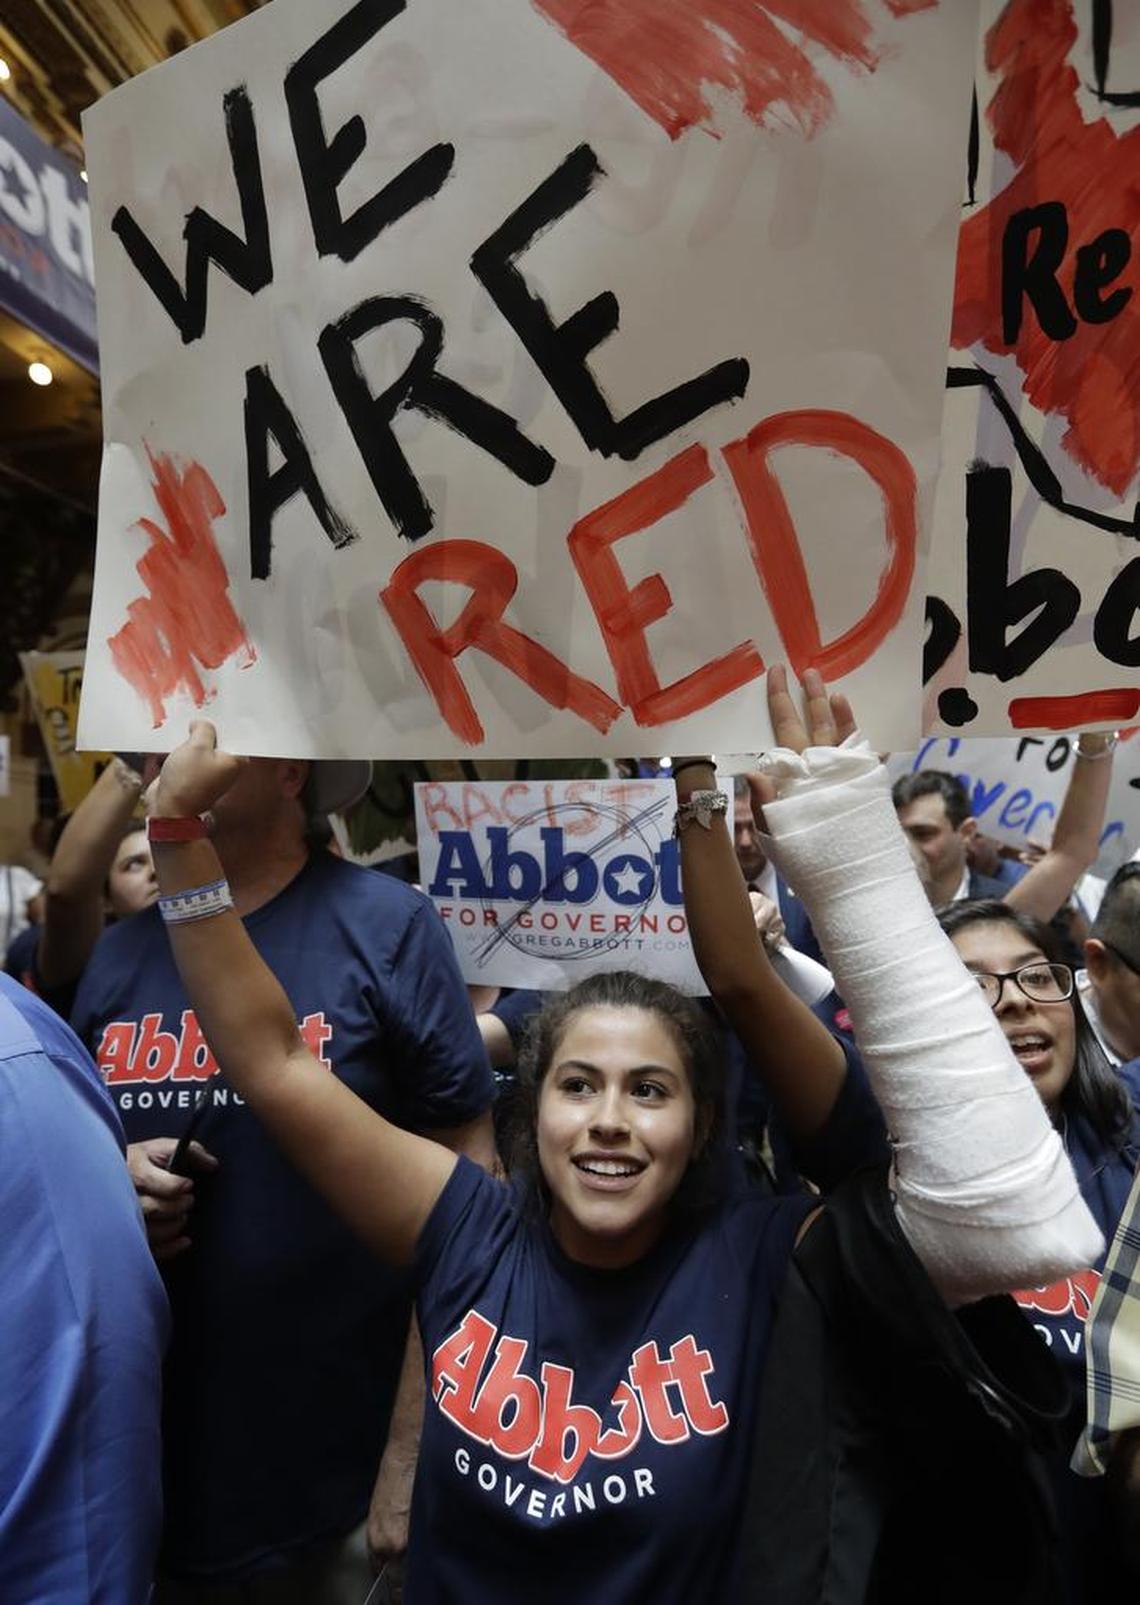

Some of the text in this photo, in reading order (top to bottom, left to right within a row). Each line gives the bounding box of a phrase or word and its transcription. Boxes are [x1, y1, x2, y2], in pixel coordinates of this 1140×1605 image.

[111, 0, 456, 344] WE
[1001, 201, 1133, 346] Re
[243, 143, 750, 580] ARE
[379, 408, 918, 747] RED
[419, 782, 656, 843] RACIST
[428, 826, 687, 906] Abbot
[516, 911, 687, 934] GOVERNO
[432, 1309, 729, 1483] Abbott
[454, 1449, 656, 1519] GOVERNOR
